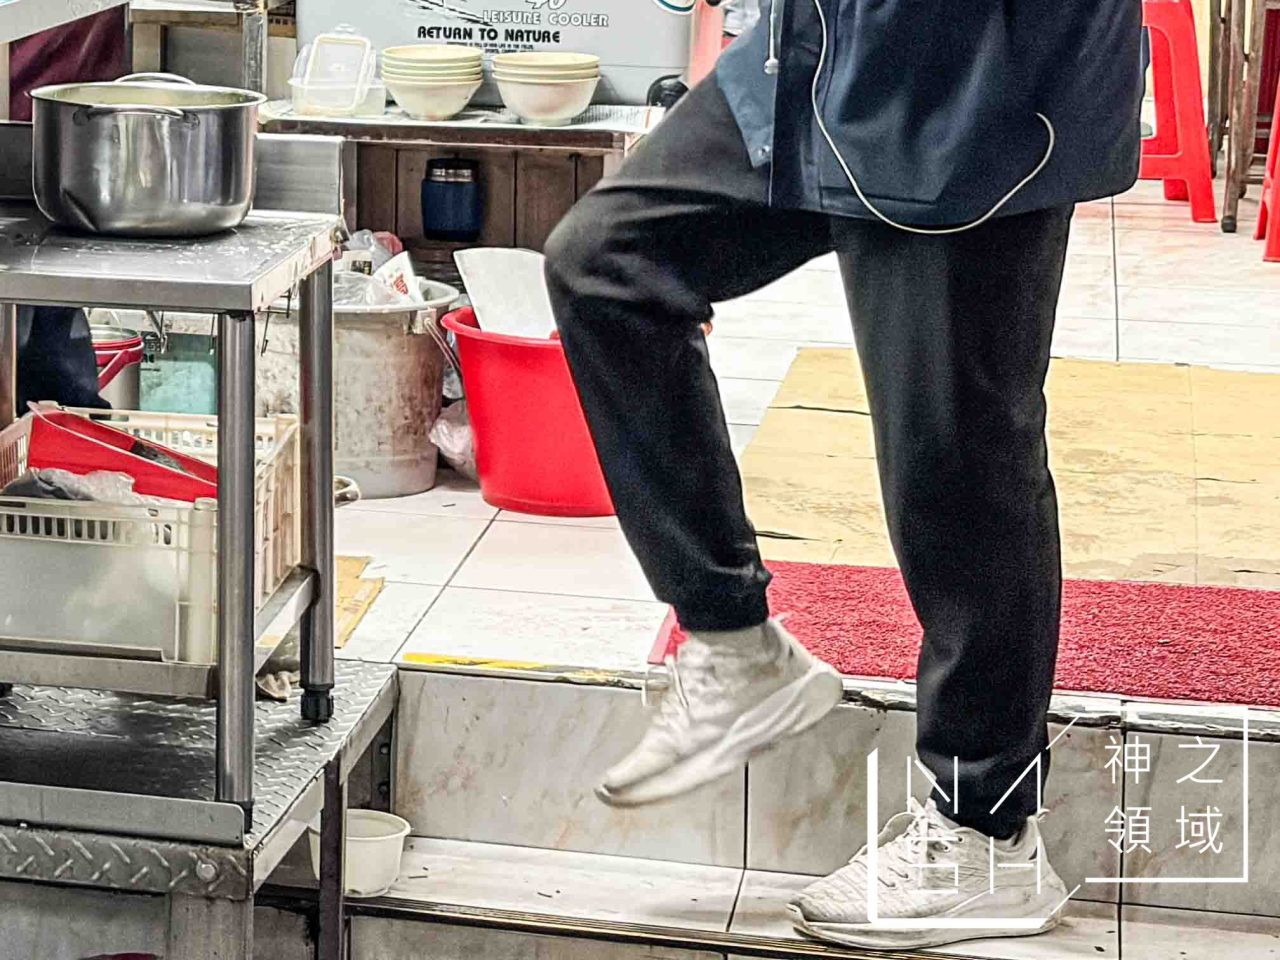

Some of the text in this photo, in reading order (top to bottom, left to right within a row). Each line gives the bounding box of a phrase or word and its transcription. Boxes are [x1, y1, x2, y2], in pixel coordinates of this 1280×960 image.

[482, 10, 609, 28] LEISURE COOLER
[418, 26, 560, 43] RETURN TO NATURE
